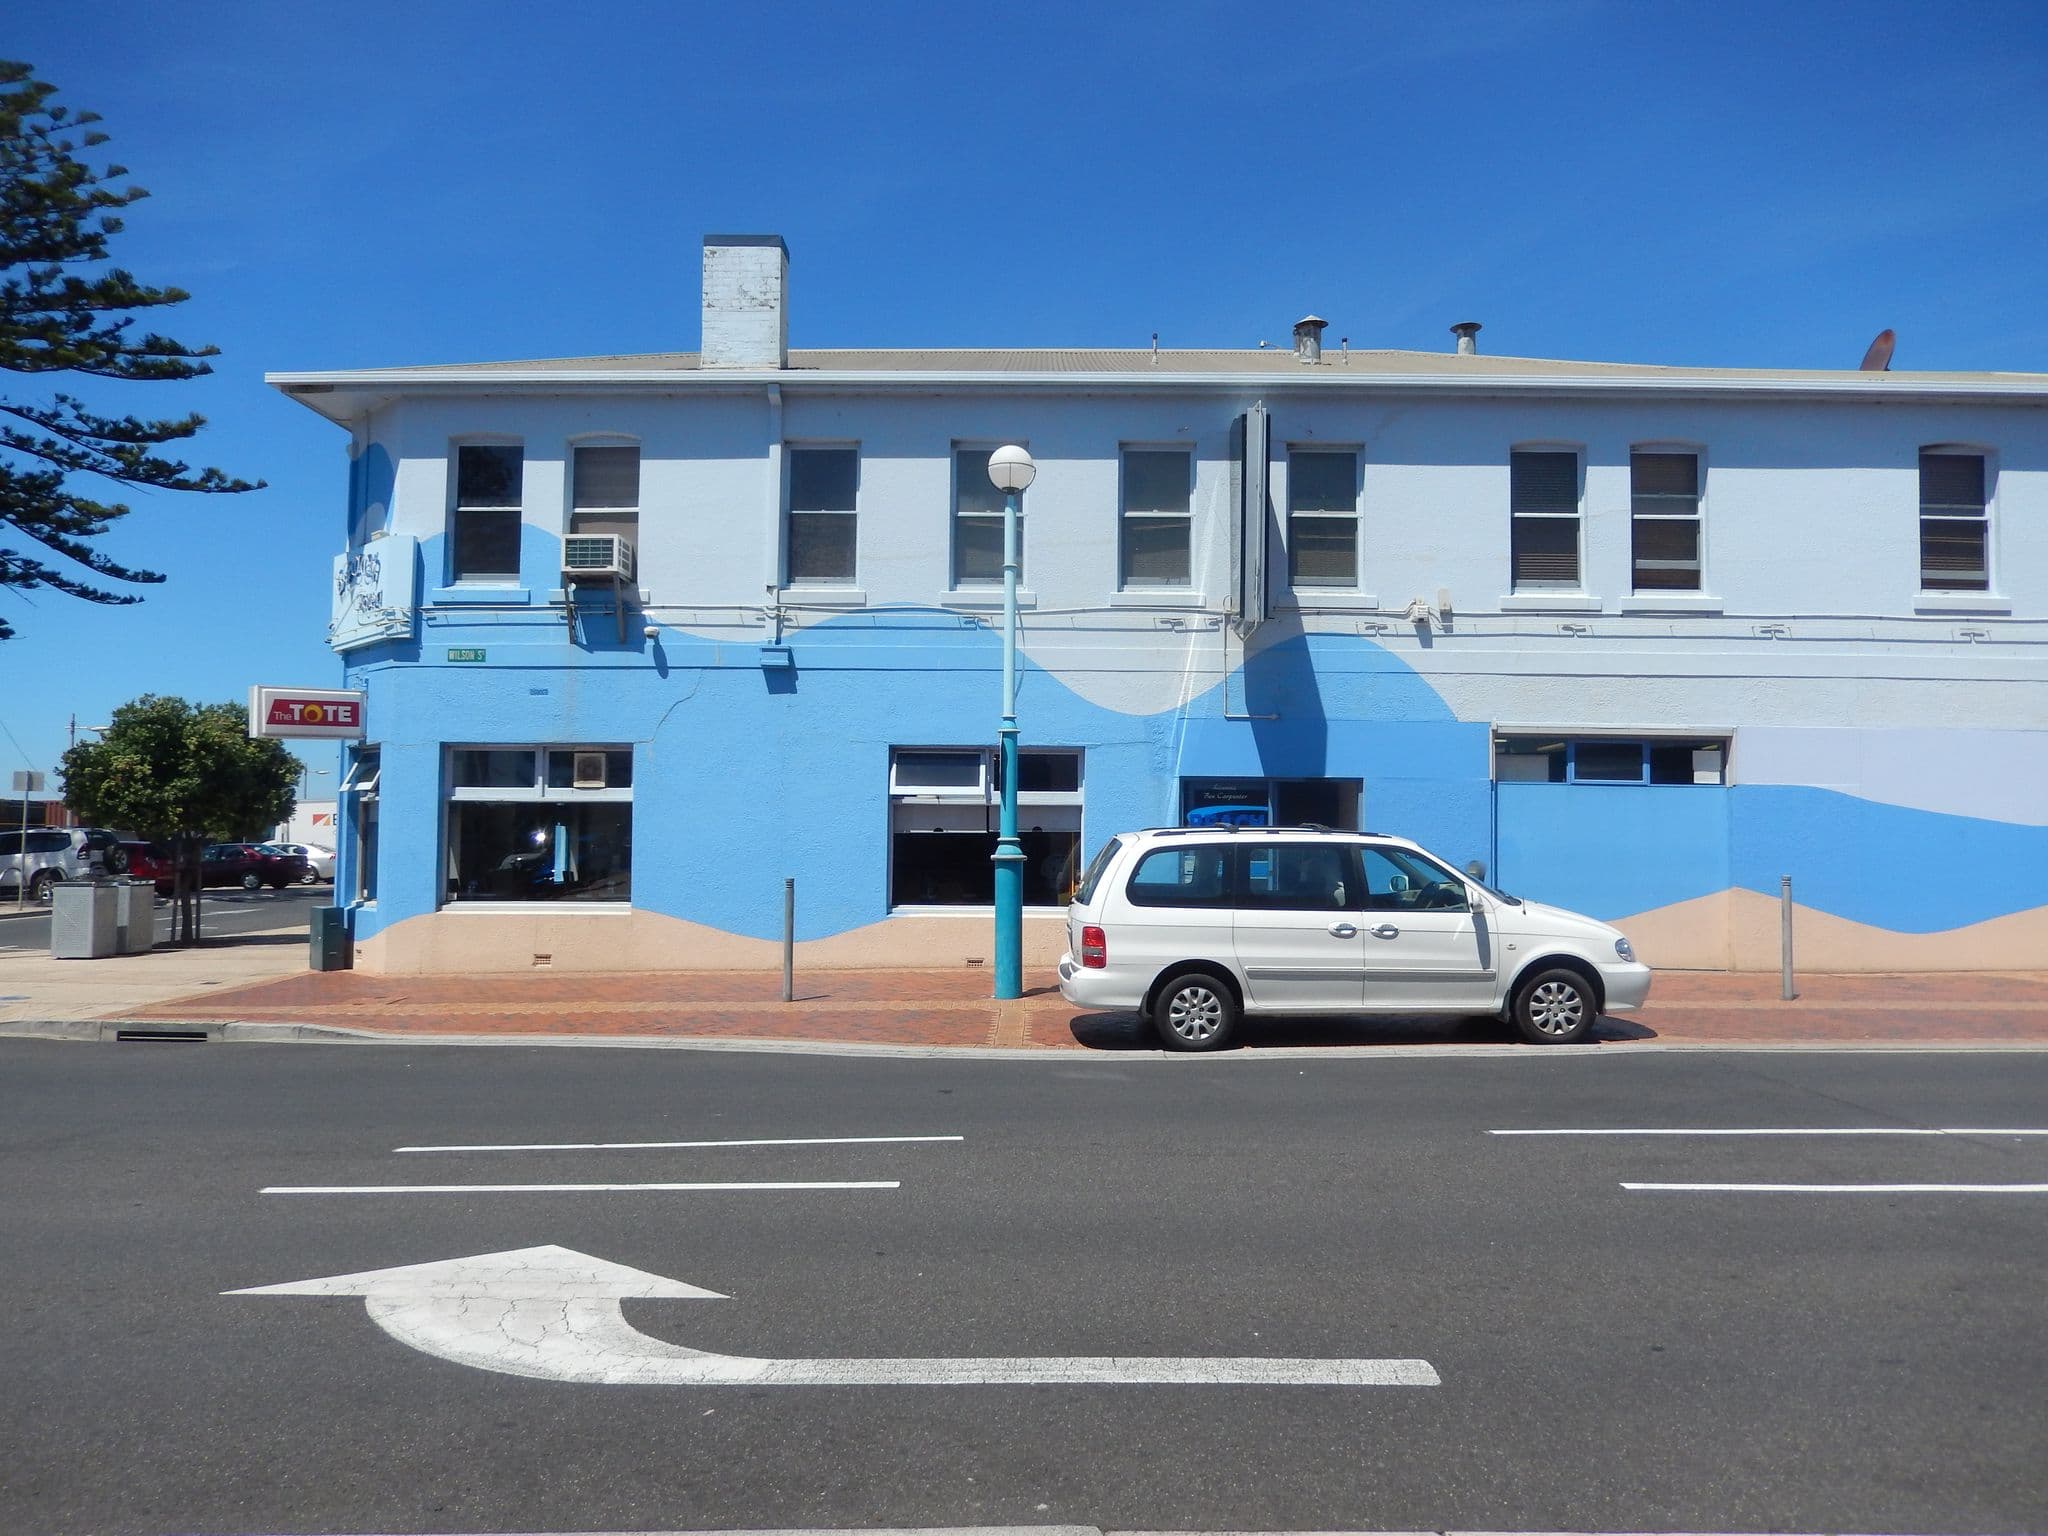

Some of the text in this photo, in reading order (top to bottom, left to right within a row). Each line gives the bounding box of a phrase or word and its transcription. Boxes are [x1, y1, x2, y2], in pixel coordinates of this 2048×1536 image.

[448, 650, 475, 661] WILSON
[273, 704, 352, 723] The TOTE
